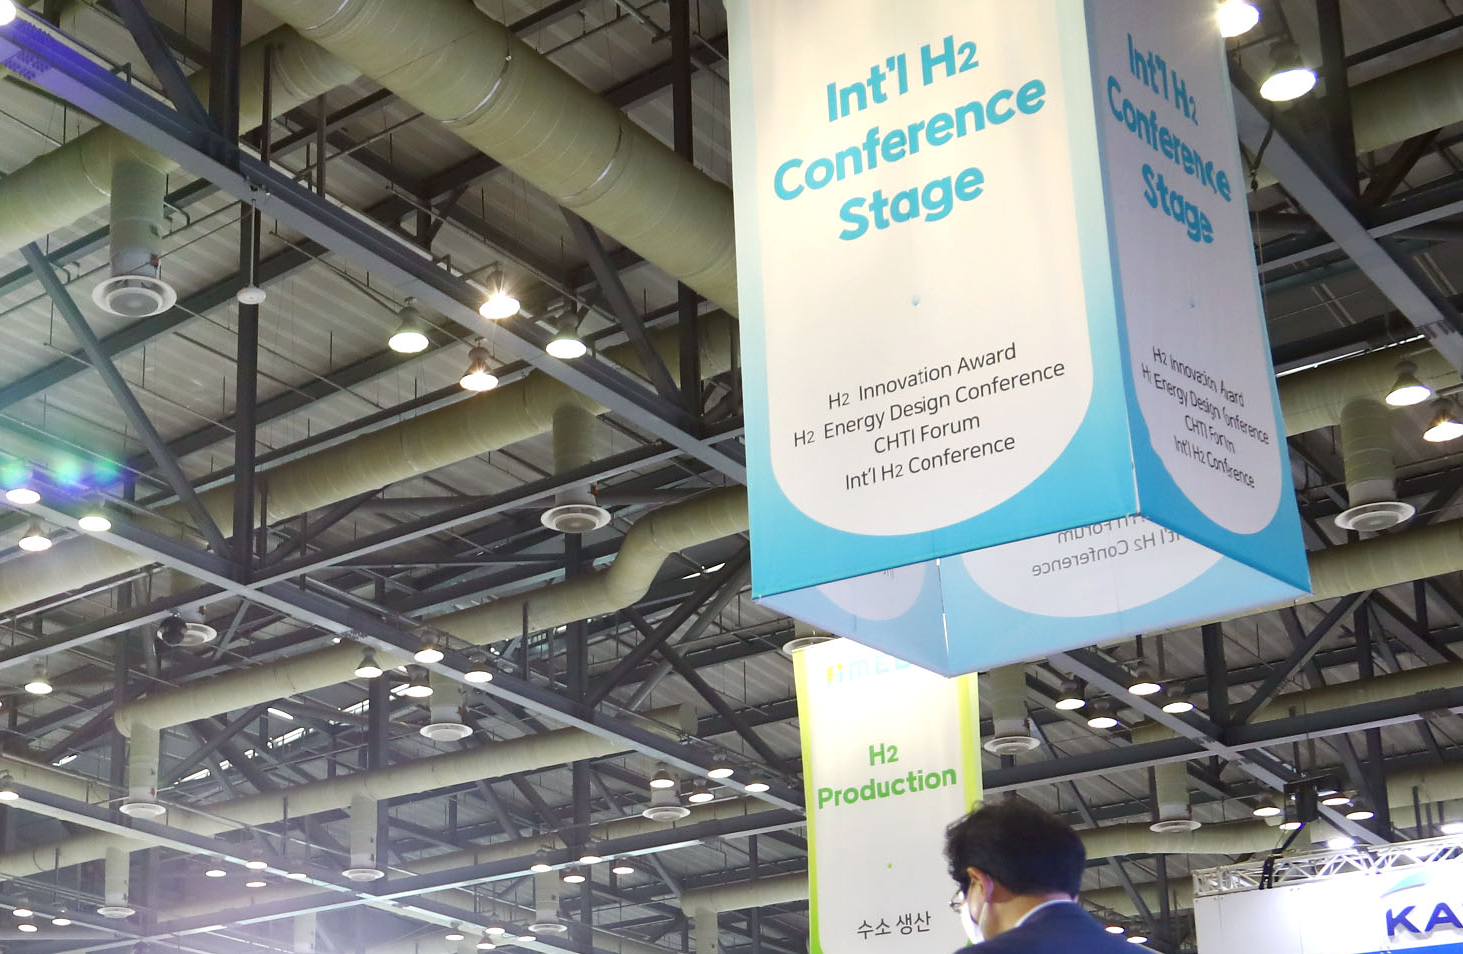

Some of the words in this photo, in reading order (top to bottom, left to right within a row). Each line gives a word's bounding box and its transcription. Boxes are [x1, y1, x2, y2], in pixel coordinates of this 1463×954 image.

[827, 53, 908, 123] Int'l
[920, 35, 979, 86] H2
[774, 79, 1046, 200] Conference
[1107, 75, 1232, 202] Conference
[838, 167, 985, 241] Stage
[1142, 163, 1214, 244] Stage
[793, 430, 815, 447] H2
[823, 411, 885, 440] Energy
[890, 394, 950, 421] Design
[955, 363, 1065, 403] Conference
[828, 392, 850, 410] H2
[859, 365, 952, 401] Innovation
[957, 342, 1016, 374] Award
[1154, 373, 1188, 407] Energy
[1189, 390, 1221, 420] Design
[845, 467, 876, 490] Int'l
[881, 463, 903, 481] H2
[908, 436, 1016, 474] Conference
[874, 429, 915, 454] CHTI
[921, 415, 980, 442] Forum
[817, 767, 957, 810] Production
[868, 743, 899, 766] H2
[857, 918, 891, 940] 수소
[896, 910, 931, 937] 생산
